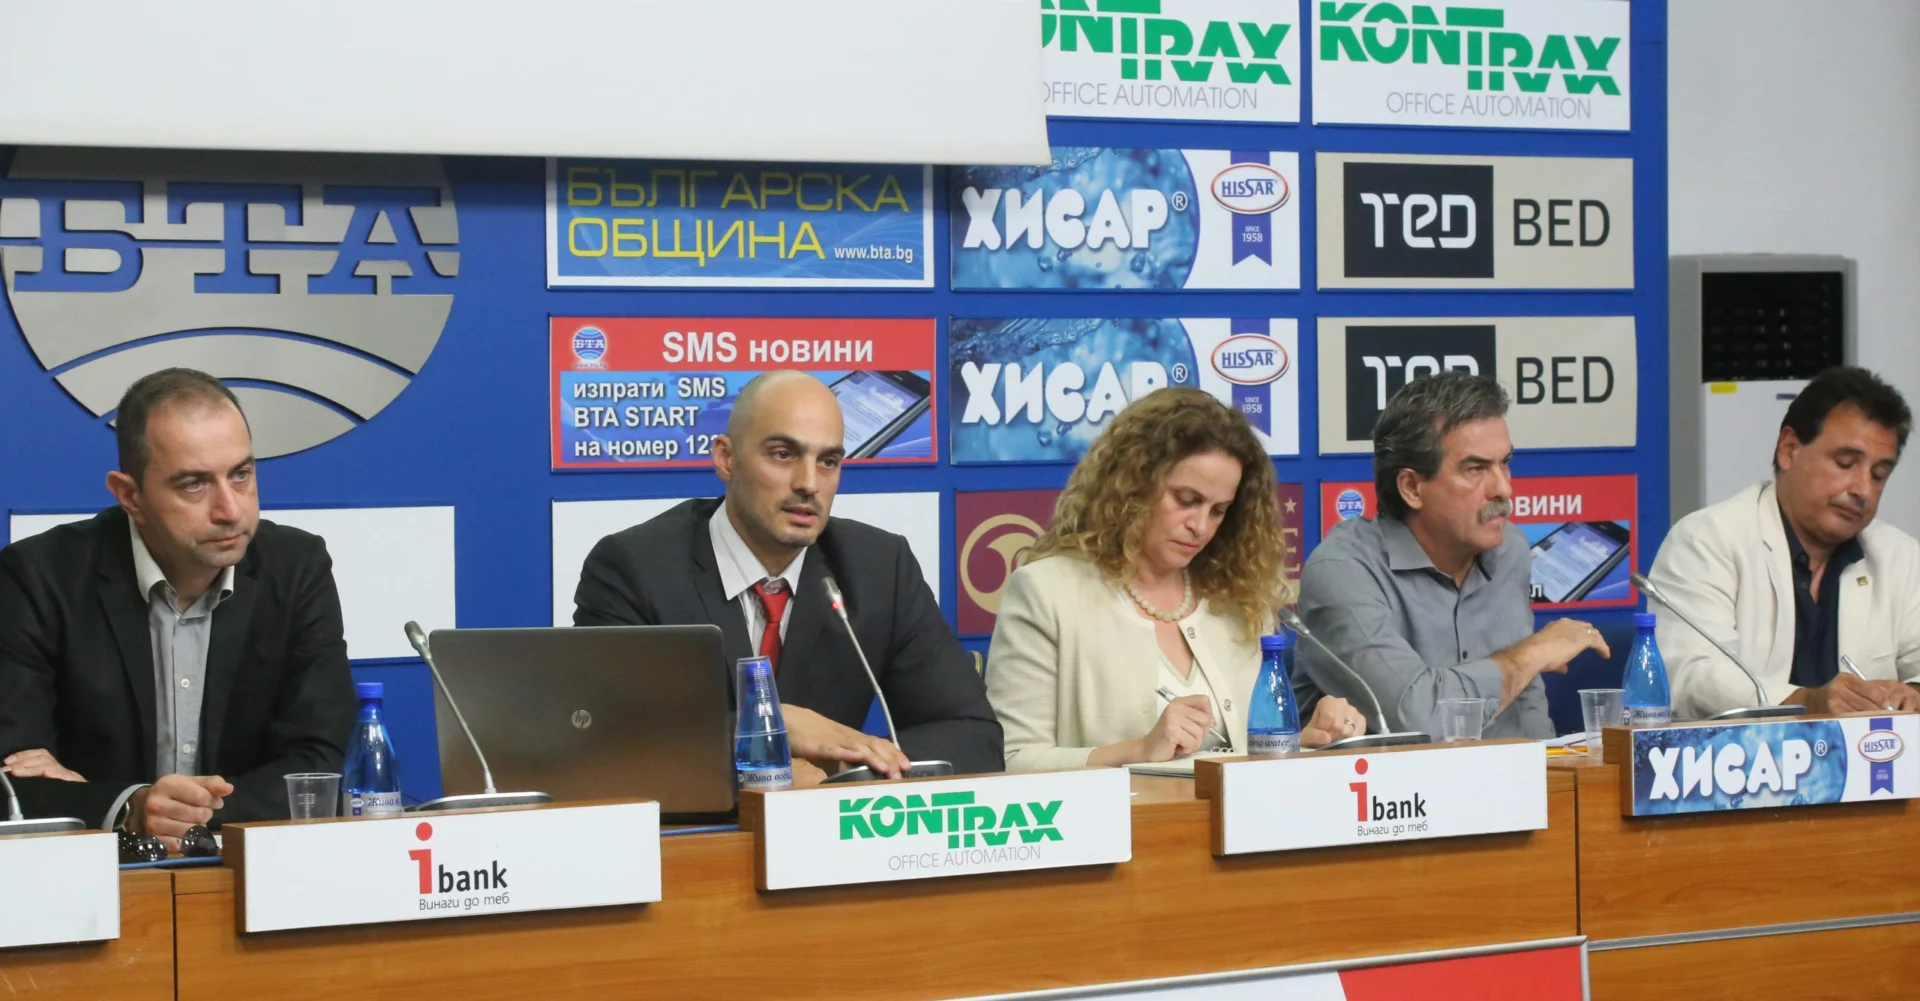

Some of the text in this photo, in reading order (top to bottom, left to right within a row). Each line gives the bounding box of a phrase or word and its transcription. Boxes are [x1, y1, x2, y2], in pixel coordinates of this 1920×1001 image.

[1320, 2, 1621, 96] KONTRAX
[1114, 85, 1257, 109] AUTOMATION
[1386, 92, 1591, 119] OFFICE AUTOMATION
[567, 168, 910, 212] БЪЛГАРСКА
[1222, 179, 1275, 197] HISSAR
[1513, 198, 1610, 247] BED
[0, 180, 458, 295] БТА
[568, 217, 826, 267] ОБЩИНА
[1242, 233, 1263, 242] 1958
[835, 245, 914, 263] www.bta.bg
[662, 332, 873, 363] SMS новини
[1222, 349, 1275, 368] HISSAR
[574, 377, 726, 402] изпрати SMS
[1516, 356, 1614, 405] BED
[625, 405, 698, 426] START
[575, 440, 600, 456] на
[608, 439, 678, 460] номер
[1509, 494, 1582, 516] вини
[1864, 739, 1897, 752] HISSAR
[839, 790, 1064, 849] KONTRAX
[1357, 822, 1390, 837] Винаги
[1392, 822, 1405, 837] до
[888, 844, 1041, 871] OFFICE AUTOMATION
[418, 894, 460, 911] Винаги
[464, 896, 480, 911] до
